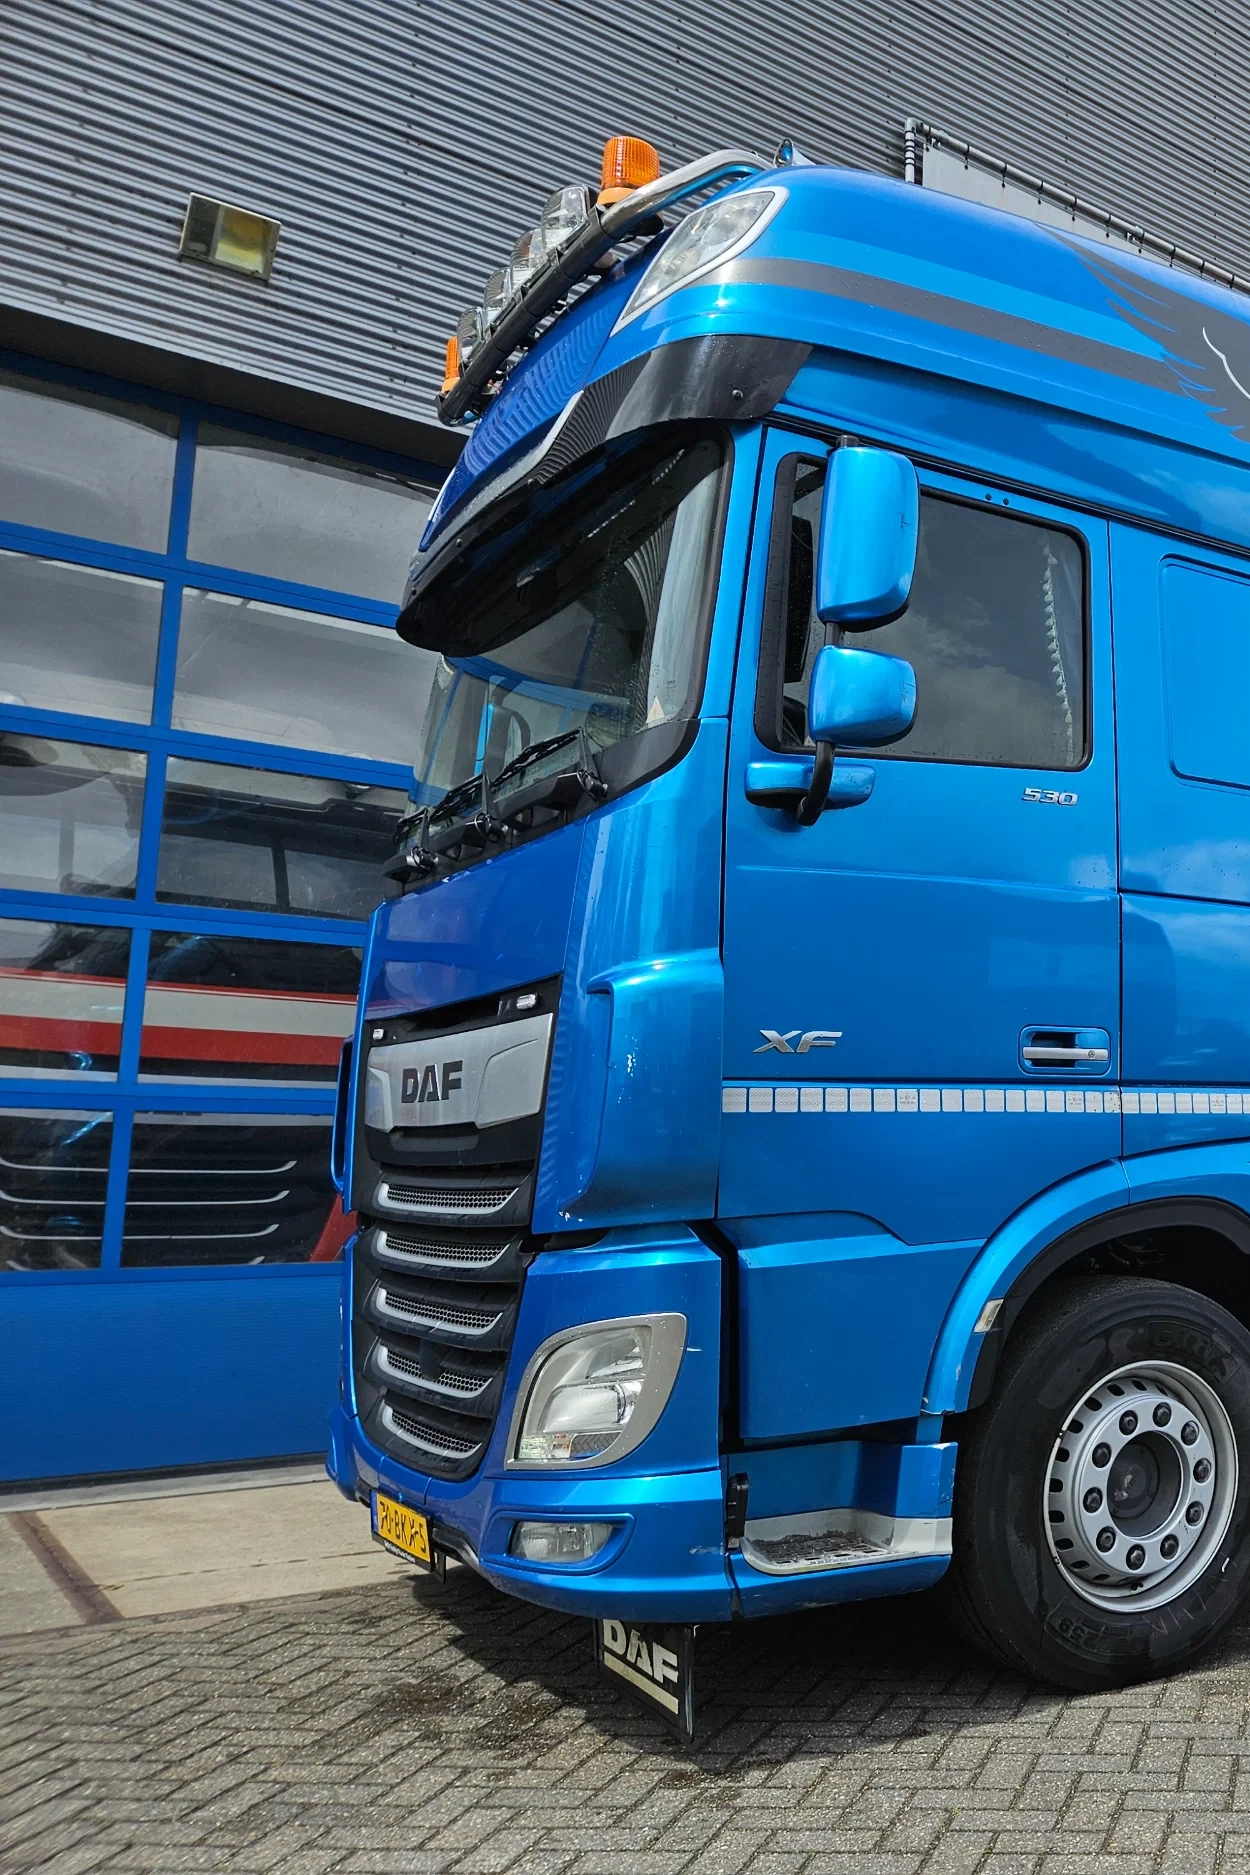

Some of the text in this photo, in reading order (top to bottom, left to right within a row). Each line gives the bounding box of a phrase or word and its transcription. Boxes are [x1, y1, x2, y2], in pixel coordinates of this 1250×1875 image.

[1023, 787, 1078, 806] 530
[752, 1029, 843, 1053] XF
[401, 1060, 463, 1103] DAF
[602, 1619, 679, 1684] DAF
